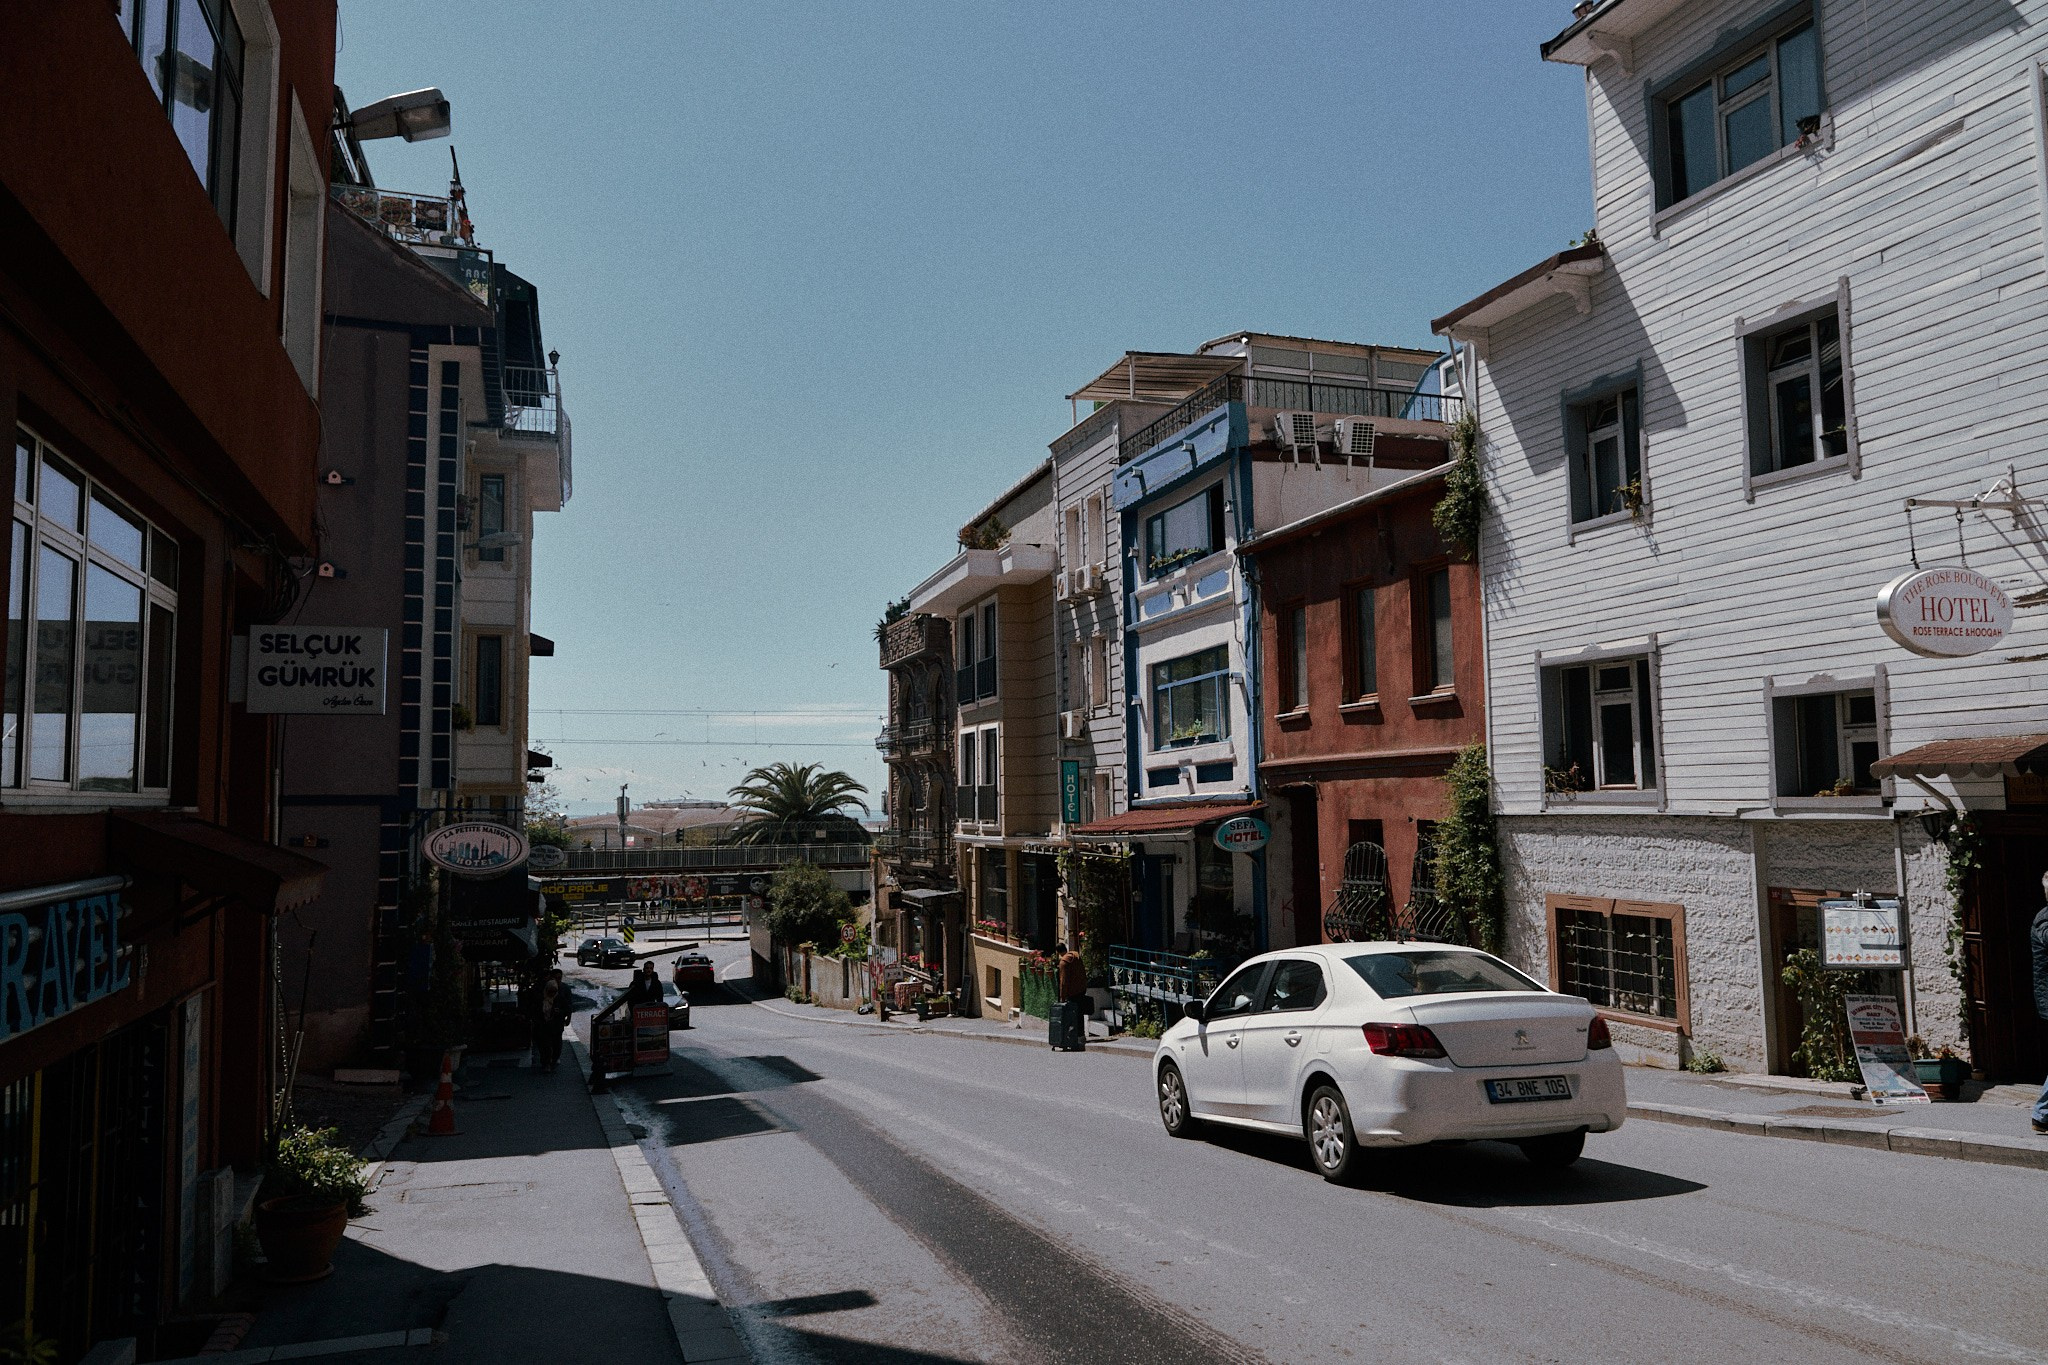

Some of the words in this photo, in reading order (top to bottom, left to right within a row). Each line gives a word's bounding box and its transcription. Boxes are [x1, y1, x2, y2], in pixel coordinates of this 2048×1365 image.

[1903, 581, 1925, 604] THE
[1925, 572, 1952, 588] ROSE
[1954, 571, 2008, 609] BOUQUETS
[1920, 596, 1995, 622] HOTEL
[1913, 626, 1932, 636] ROSE
[1933, 627, 1963, 637] TERRACE
[259, 633, 362, 659] SELÇUK
[257, 660, 375, 688] GÜMRÜK
[1066, 774, 1076, 821] HOTEL
[1229, 820, 1256, 831] SEFA
[443, 831, 454, 839] LA
[455, 826, 481, 835] PETITE
[482, 826, 511, 840] MAISON
[1223, 830, 1265, 843] HOTEL
[456, 857, 494, 867] HOTEL
[541, 885, 565, 894] 400
[568, 883, 609, 893] PROJE
[636, 1009, 666, 1018] TERRACE
[1496, 1082, 1512, 1097] 34
[1517, 1080, 1541, 1096] BNE
[1545, 1079, 1567, 1095] 105
